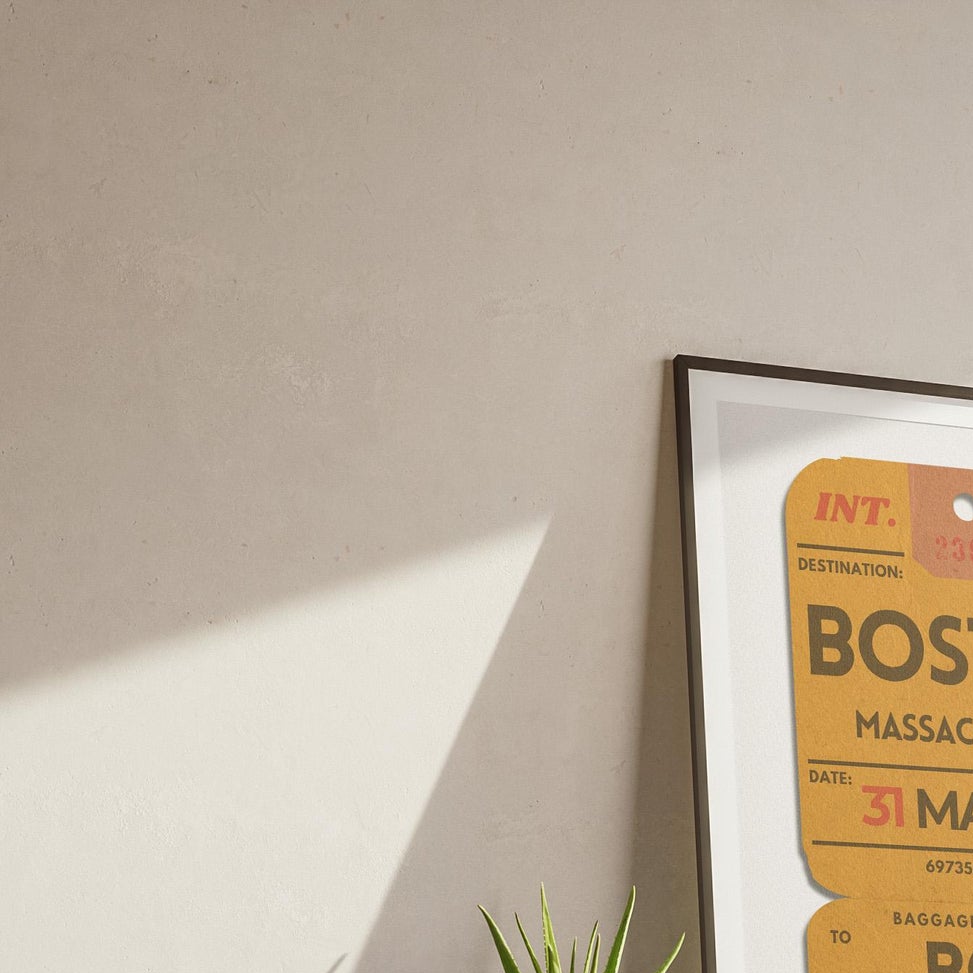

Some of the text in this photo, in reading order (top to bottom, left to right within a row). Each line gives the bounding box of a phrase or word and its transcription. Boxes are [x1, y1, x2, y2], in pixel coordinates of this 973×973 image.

[814, 492, 896, 527] INT.
[797, 557, 904, 579] DESTINATION:
[808, 769, 853, 786] DATE:
[861, 784, 905, 828] 31
[829, 929, 852, 945] TO
